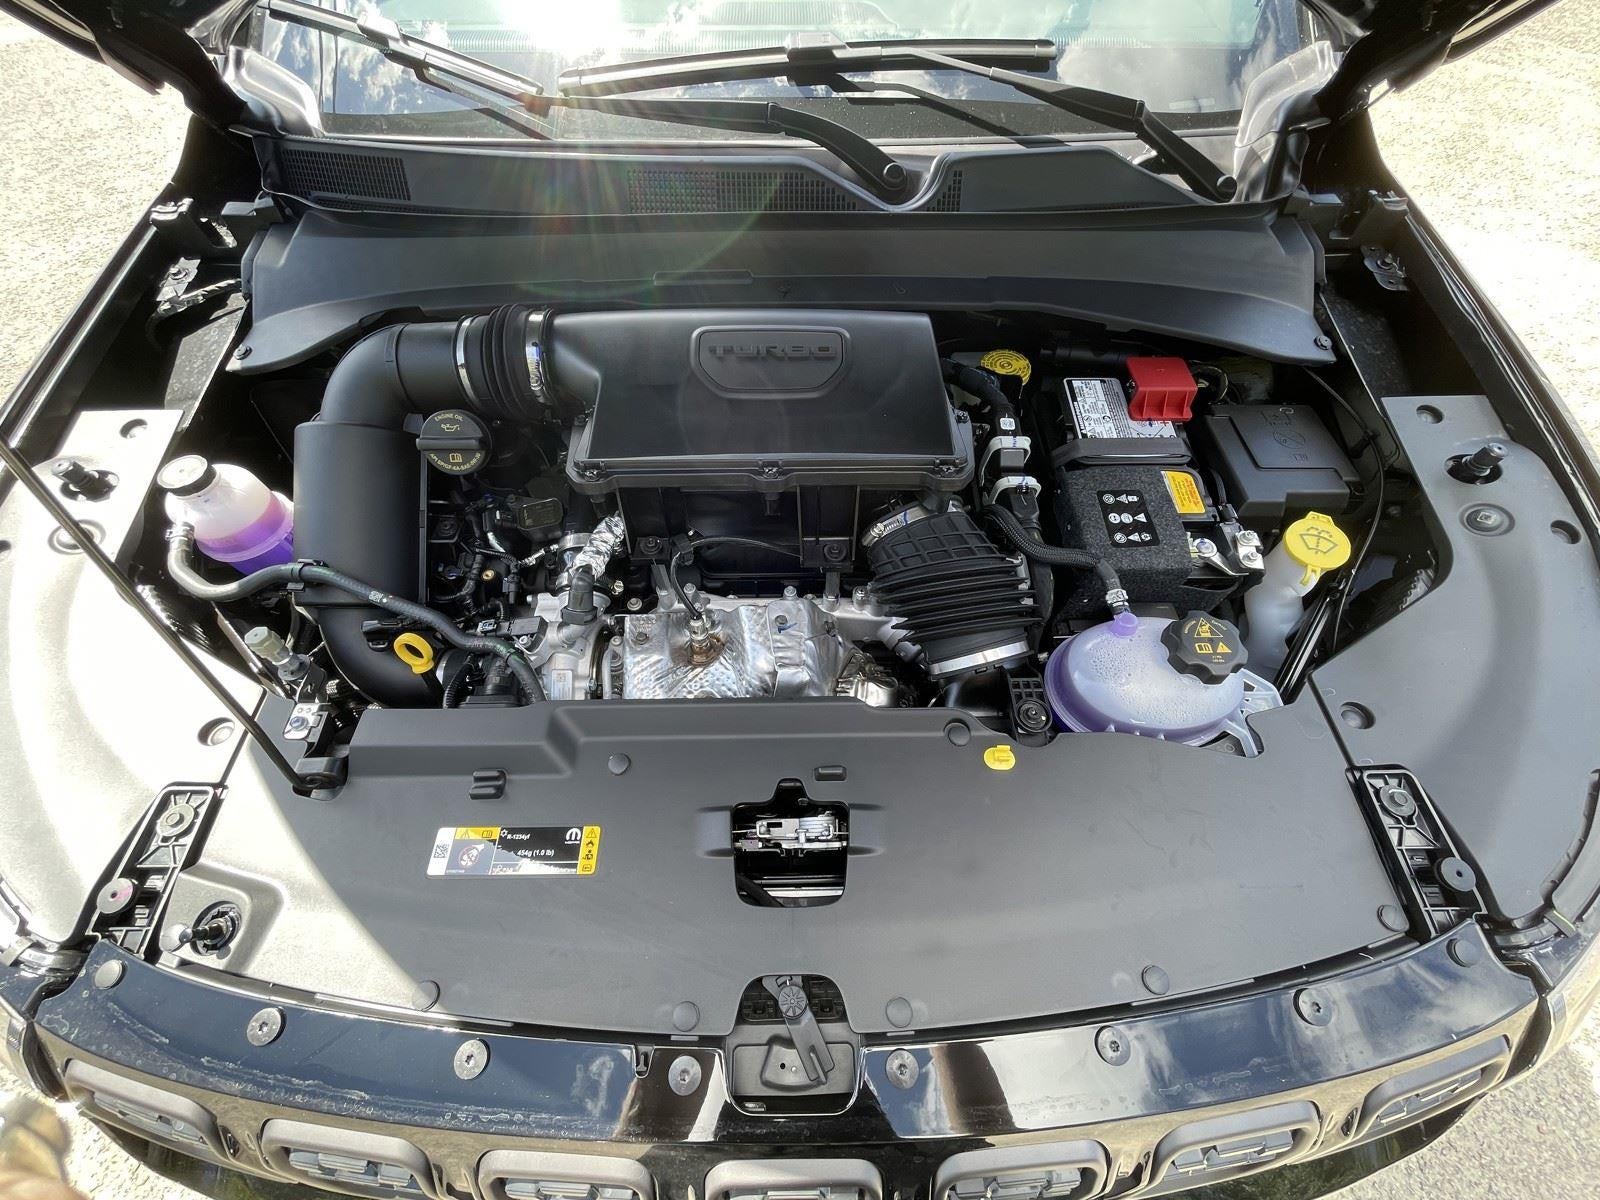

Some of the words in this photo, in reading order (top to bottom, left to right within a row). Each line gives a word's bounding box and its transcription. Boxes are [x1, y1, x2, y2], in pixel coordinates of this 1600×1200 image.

[708, 345, 838, 361] TURBO
[506, 833, 531, 841] R-1234yf
[516, 849, 532, 858] 454g
